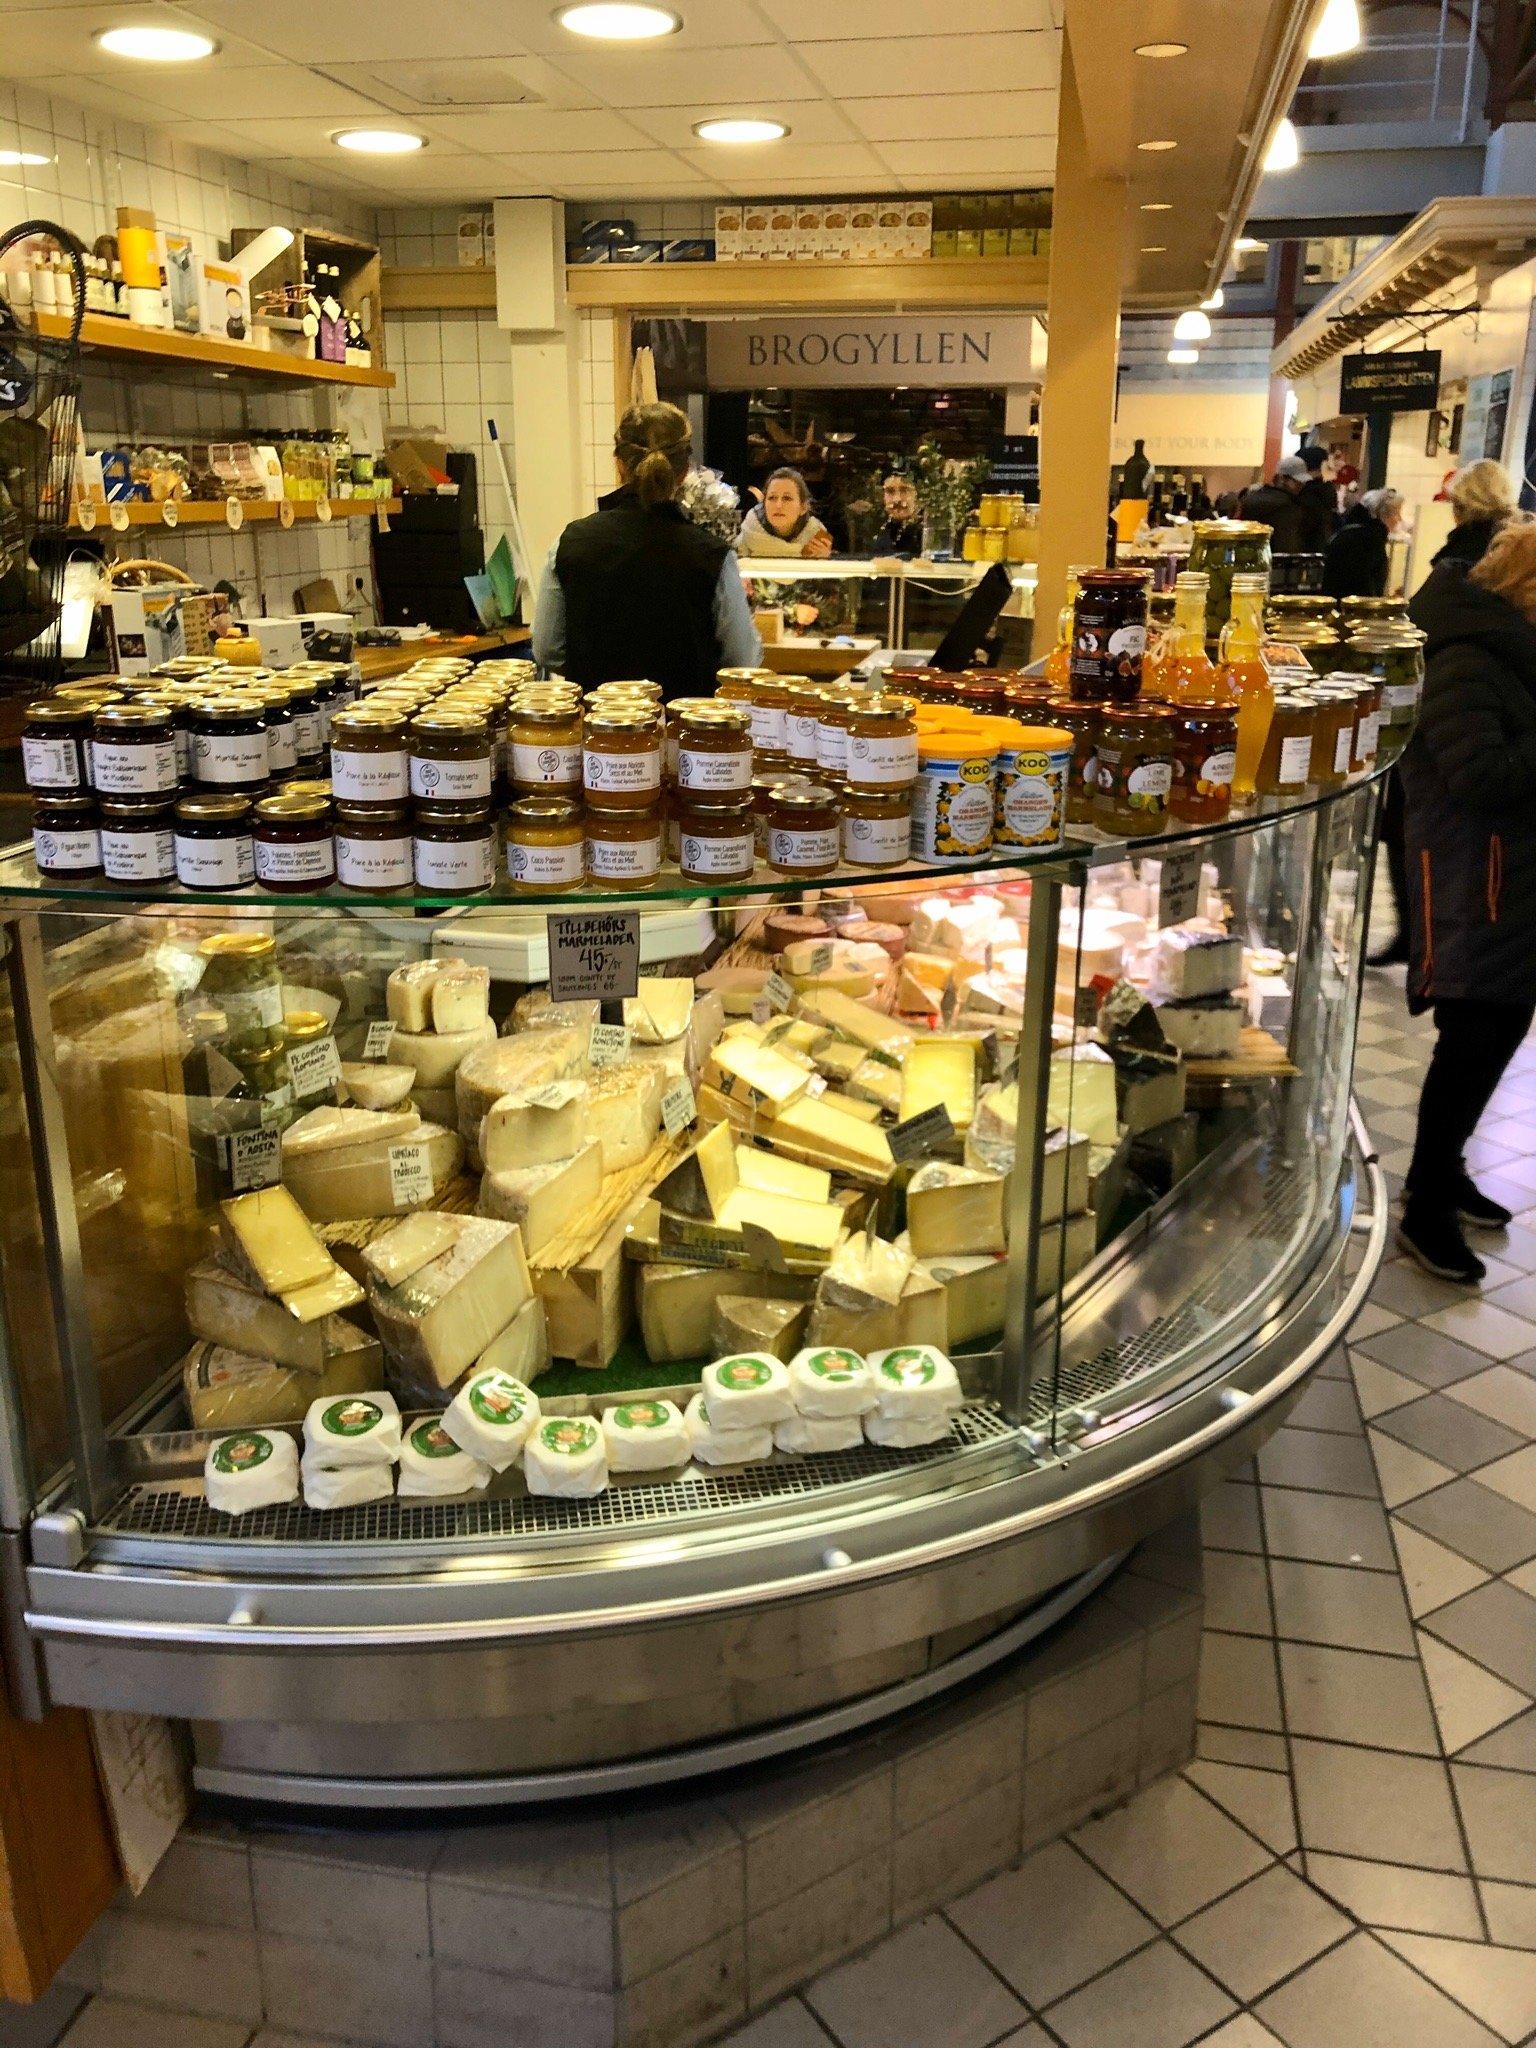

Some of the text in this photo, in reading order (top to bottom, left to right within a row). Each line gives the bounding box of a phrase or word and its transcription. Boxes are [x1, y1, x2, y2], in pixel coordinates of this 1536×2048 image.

[748, 332, 992, 366] BROGYLLEN
[963, 765, 989, 776] KOO
[1018, 759, 1049, 768] KOO
[555, 915, 626, 935] TILLBEHÖRS
[558, 932, 635, 949] MARMELADER
